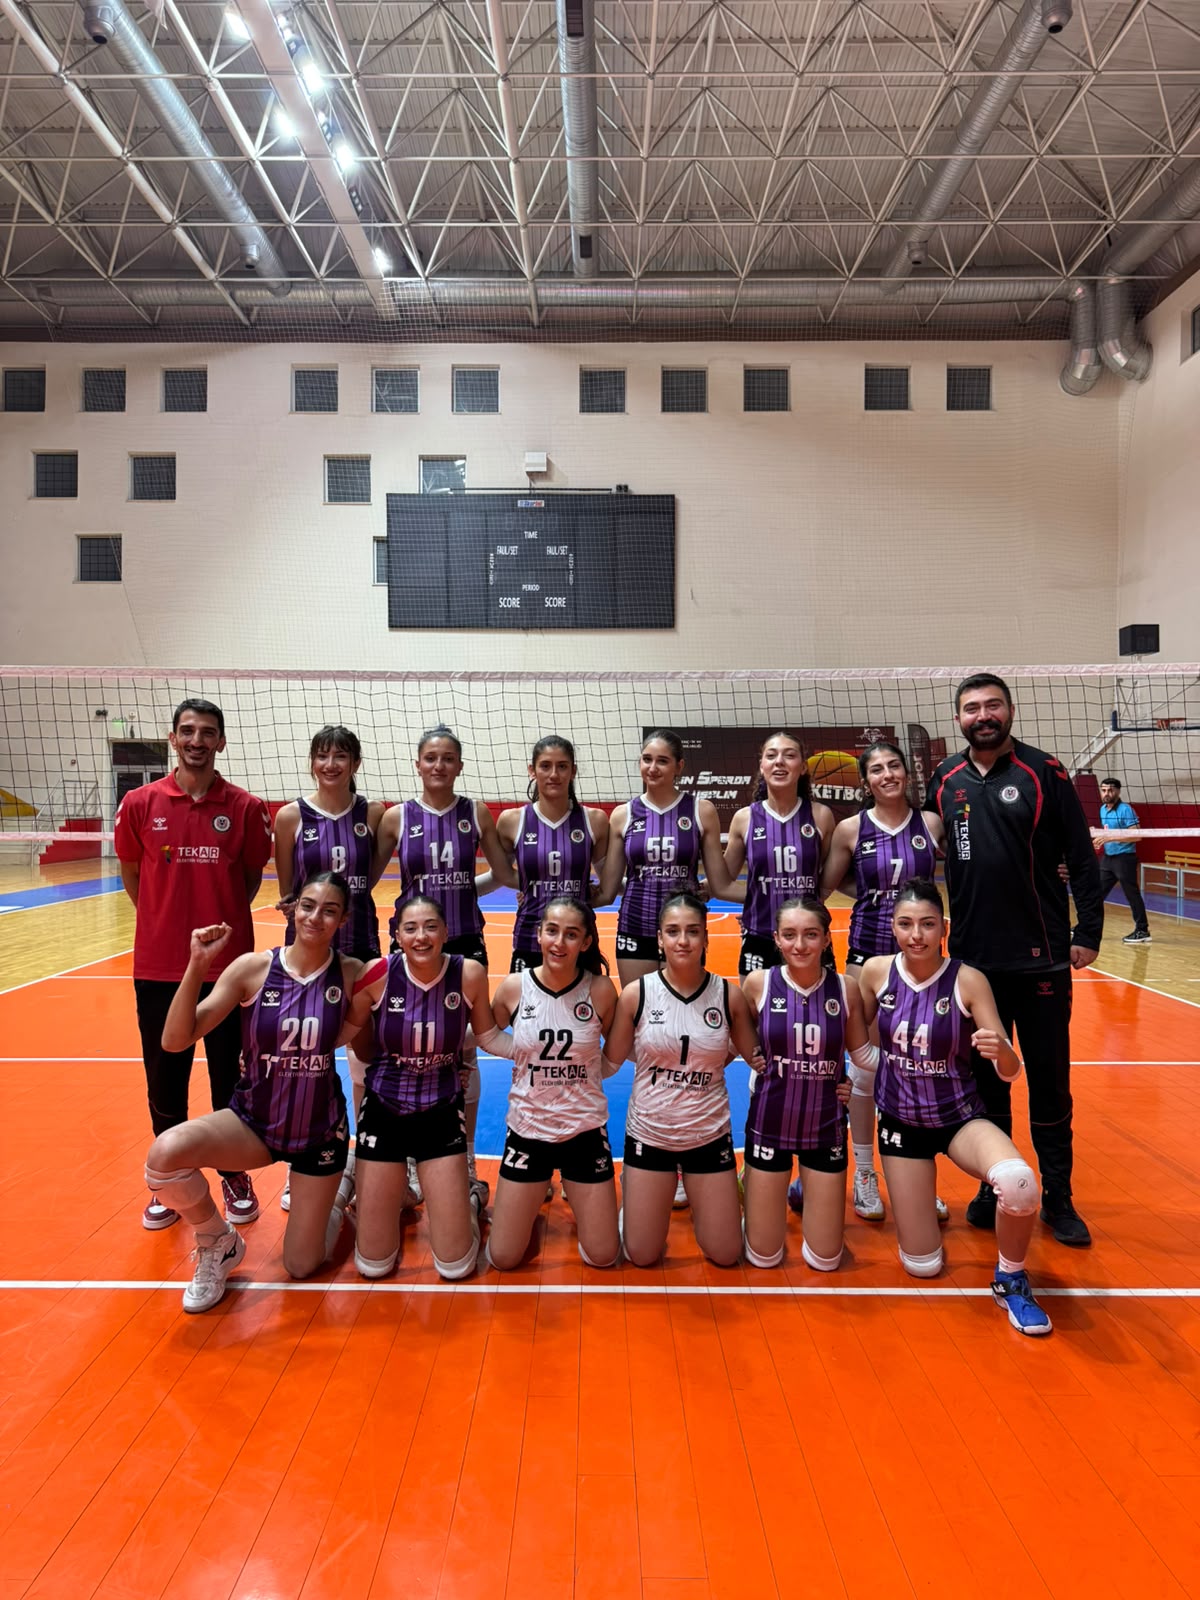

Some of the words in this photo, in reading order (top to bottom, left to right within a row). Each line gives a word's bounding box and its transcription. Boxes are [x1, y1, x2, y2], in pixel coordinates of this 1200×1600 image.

[524, 531, 538, 539] TIME
[499, 597, 520, 608] SCORE
[545, 597, 566, 607] SCORE
[178, 846, 219, 859] TEKAR
[647, 836, 675, 862] 55
[960, 819, 970, 860] TEKAR
[331, 846, 346, 873] 8
[429, 841, 455, 869] 14
[548, 851, 562, 877] 6
[773, 845, 797, 873] 16
[430, 871, 471, 884] TEKAR
[650, 866, 688, 877] TEKAR
[774, 876, 815, 889] TEKAR
[890, 858, 904, 885] 7
[543, 880, 581, 891] TEKAR
[280, 1017, 319, 1051] 20
[413, 1021, 436, 1053] 11
[539, 1029, 573, 1061] 22
[793, 1022, 821, 1056] 19
[893, 1020, 929, 1056] 44
[679, 1035, 690, 1065] 1
[542, 1065, 588, 1079] TEKAR
[666, 1069, 713, 1085] TEKAR
[791, 1060, 837, 1075] TEKAR
[898, 1056, 947, 1074] TEKAR
